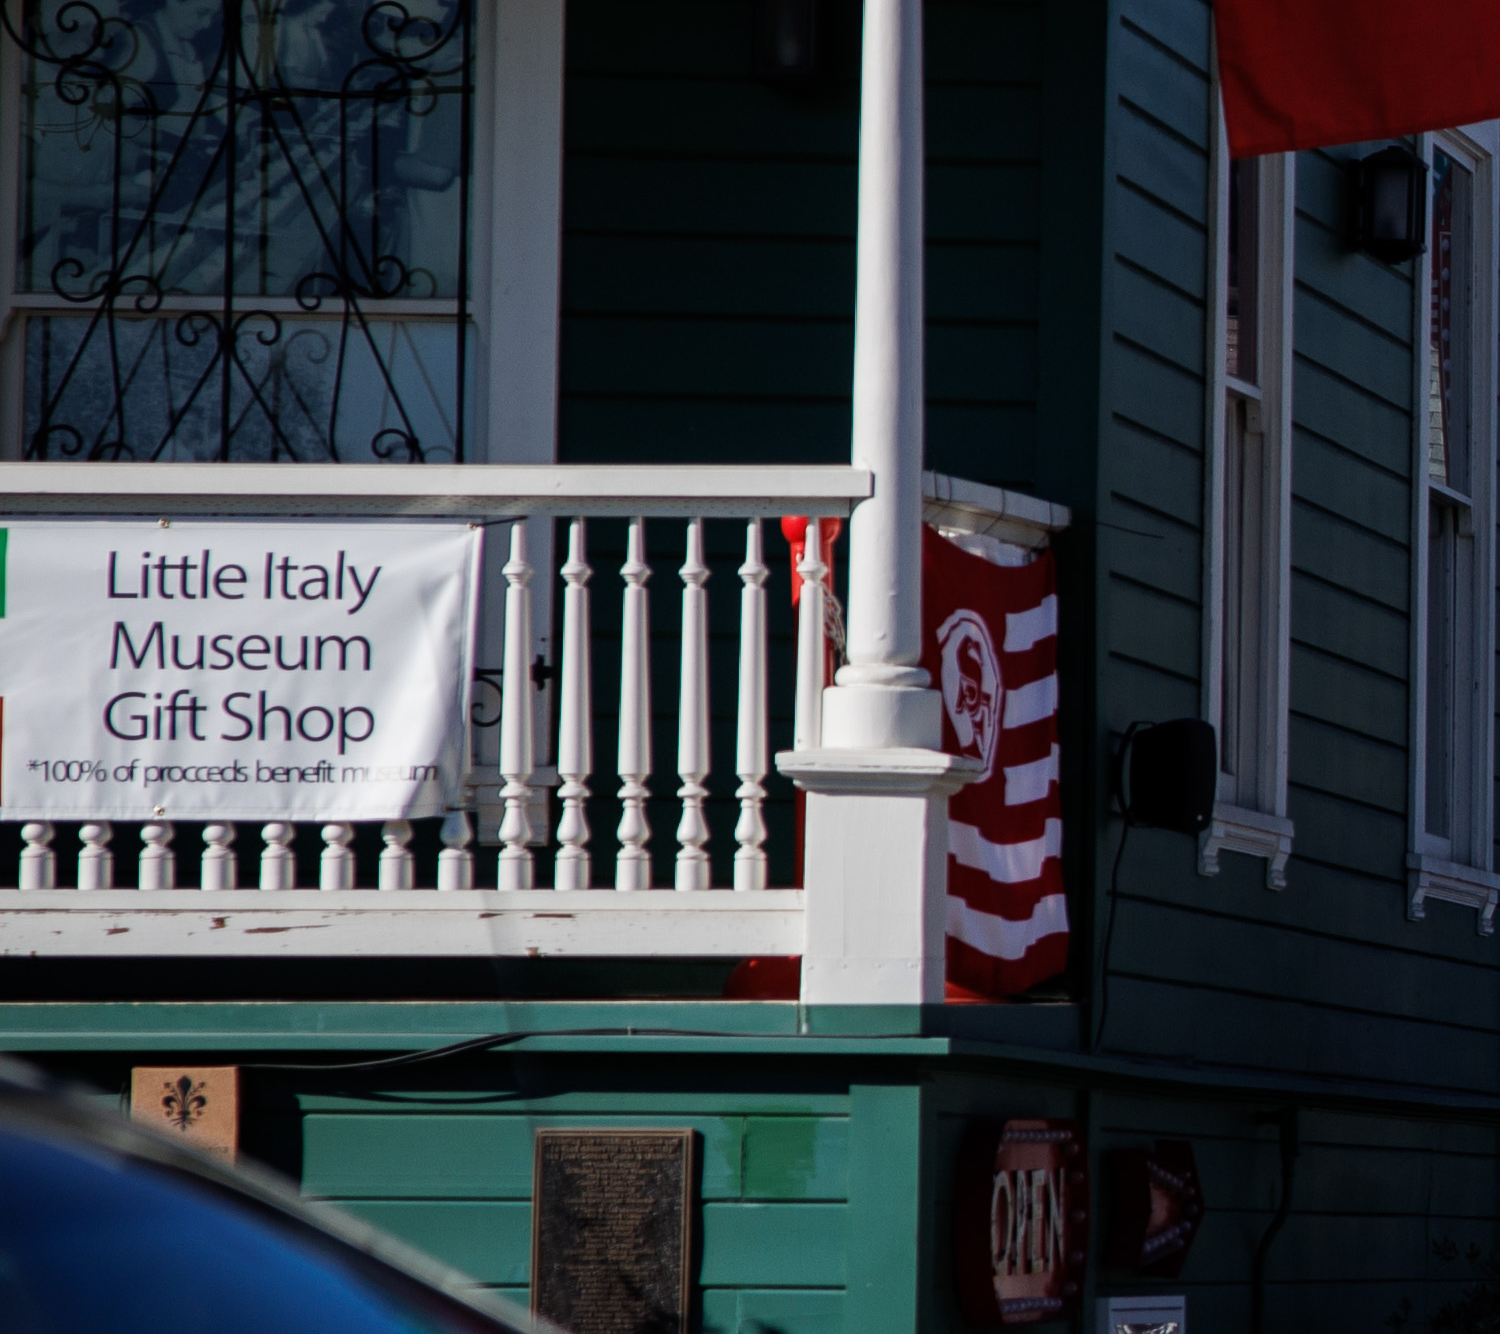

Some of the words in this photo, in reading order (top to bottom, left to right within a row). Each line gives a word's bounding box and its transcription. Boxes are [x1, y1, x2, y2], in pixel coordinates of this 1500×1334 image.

[107, 549, 247, 600] Little
[264, 550, 382, 615] Italy
[109, 621, 371, 670] Museum
[103, 689, 207, 741] Gift
[221, 690, 375, 755] Shop
[113, 758, 140, 782] of
[256, 760, 334, 783] benefit
[990, 1167, 1066, 1277] OPEN
